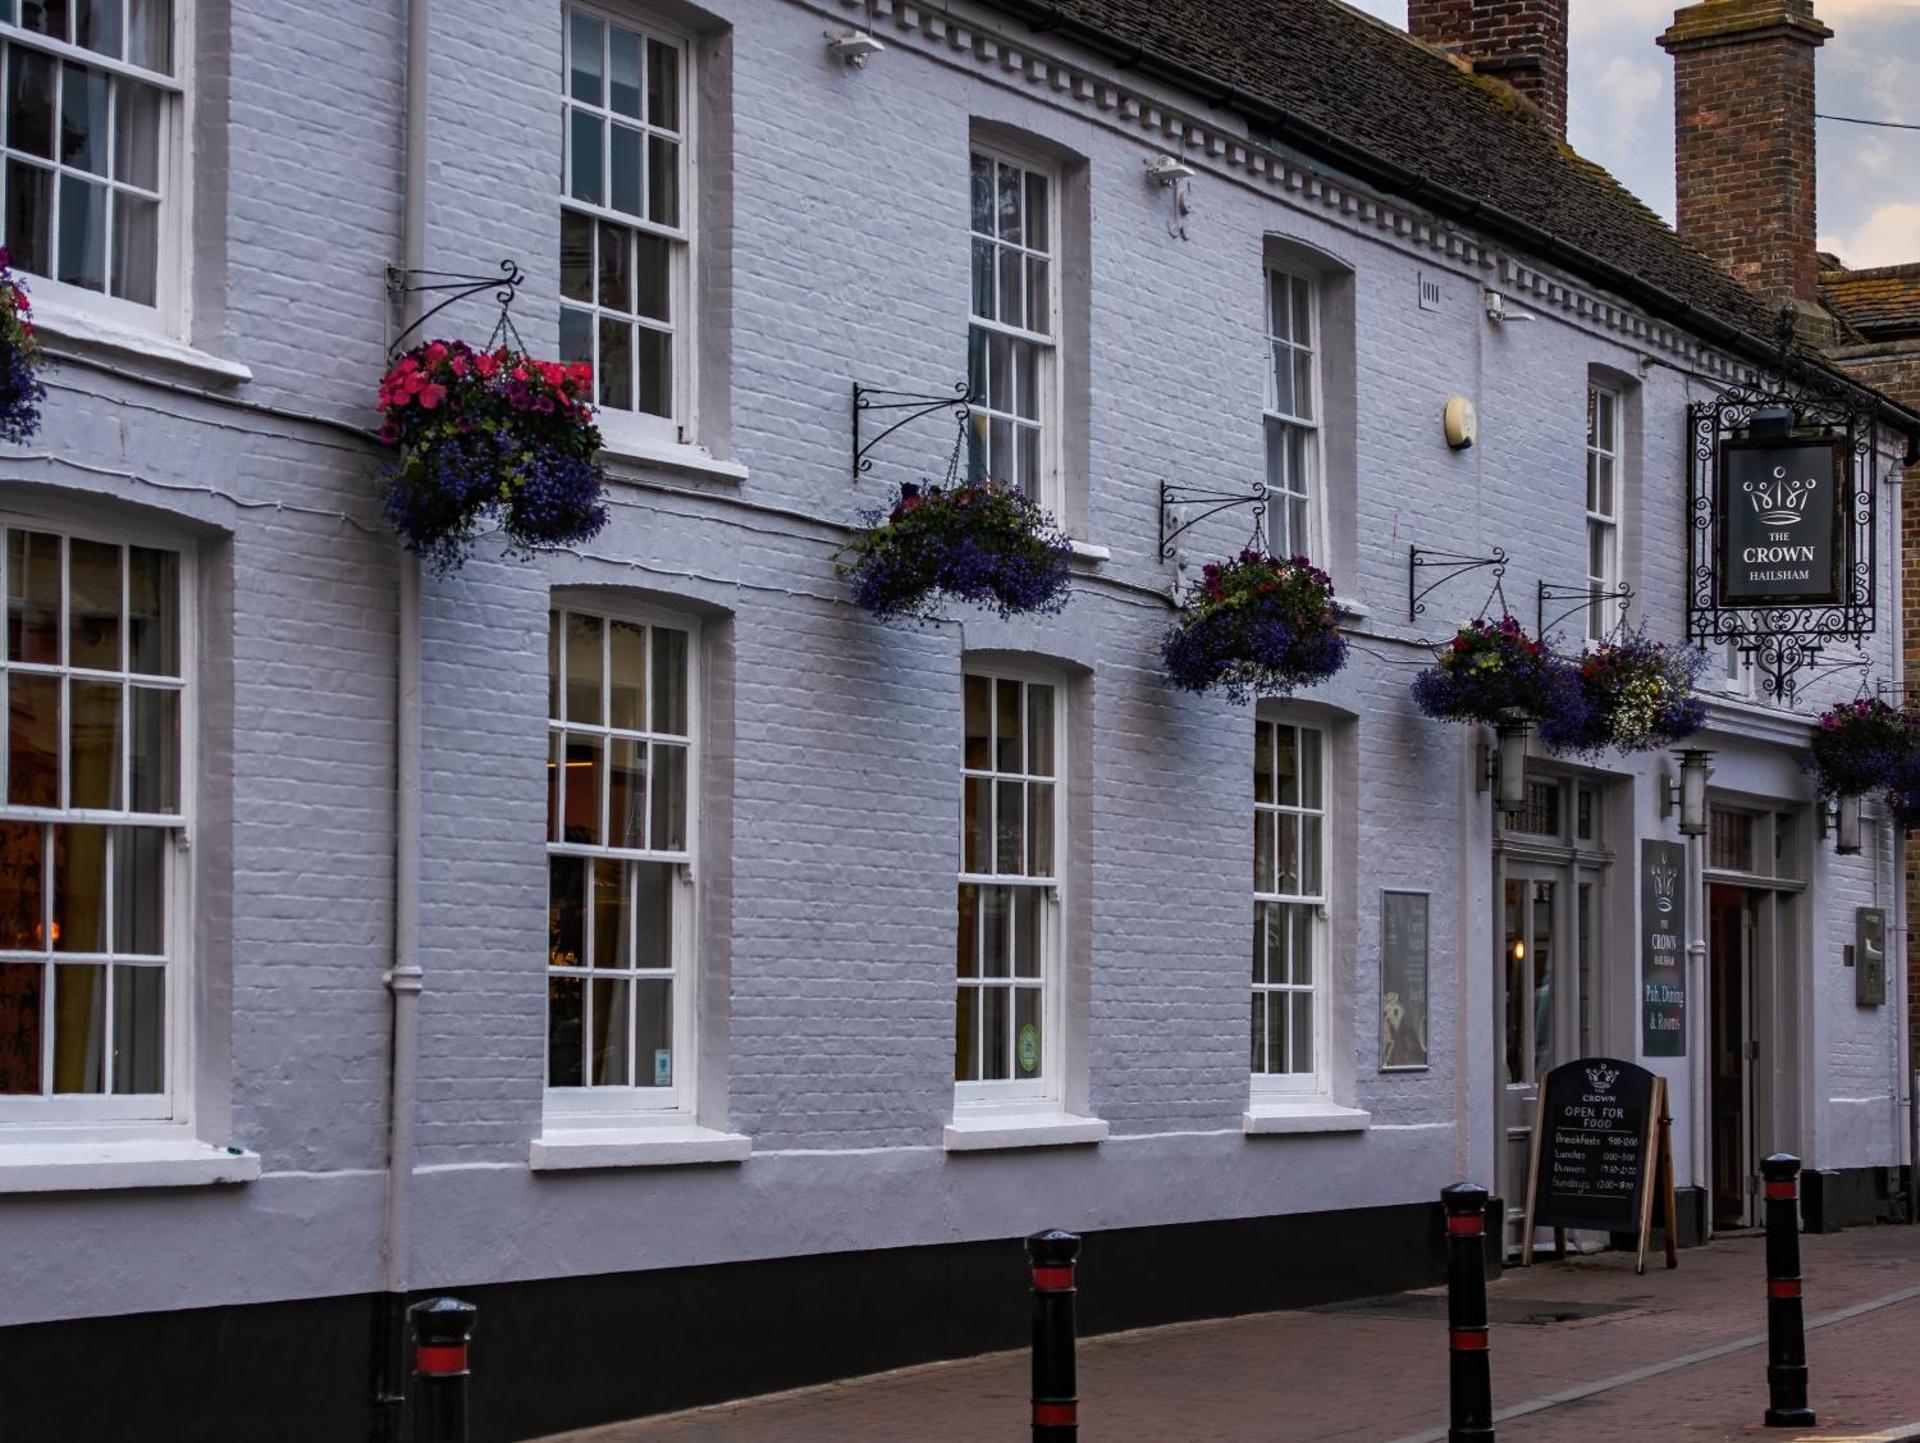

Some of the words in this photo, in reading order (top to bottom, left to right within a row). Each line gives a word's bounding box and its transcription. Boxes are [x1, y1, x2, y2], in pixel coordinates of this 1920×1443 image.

[1769, 532, 1790, 541] THE
[1743, 546, 1815, 563] CROWN
[1750, 569, 1809, 581] HAILSHAM
[1651, 934, 1677, 950] CROWN
[1662, 985, 1684, 1008] Dining
[1582, 1094, 1616, 1102] CROWN
[1564, 1106, 1595, 1118] OPEN
[1602, 1107, 1624, 1119] FOR
[1584, 1118, 1612, 1129] FOOD
[1555, 1132, 1601, 1145] Breakfasts
[1555, 1147, 1586, 1159] Lunches
[1554, 1161, 1586, 1173] Dinners
[1552, 1175, 1591, 1193] Sundays
